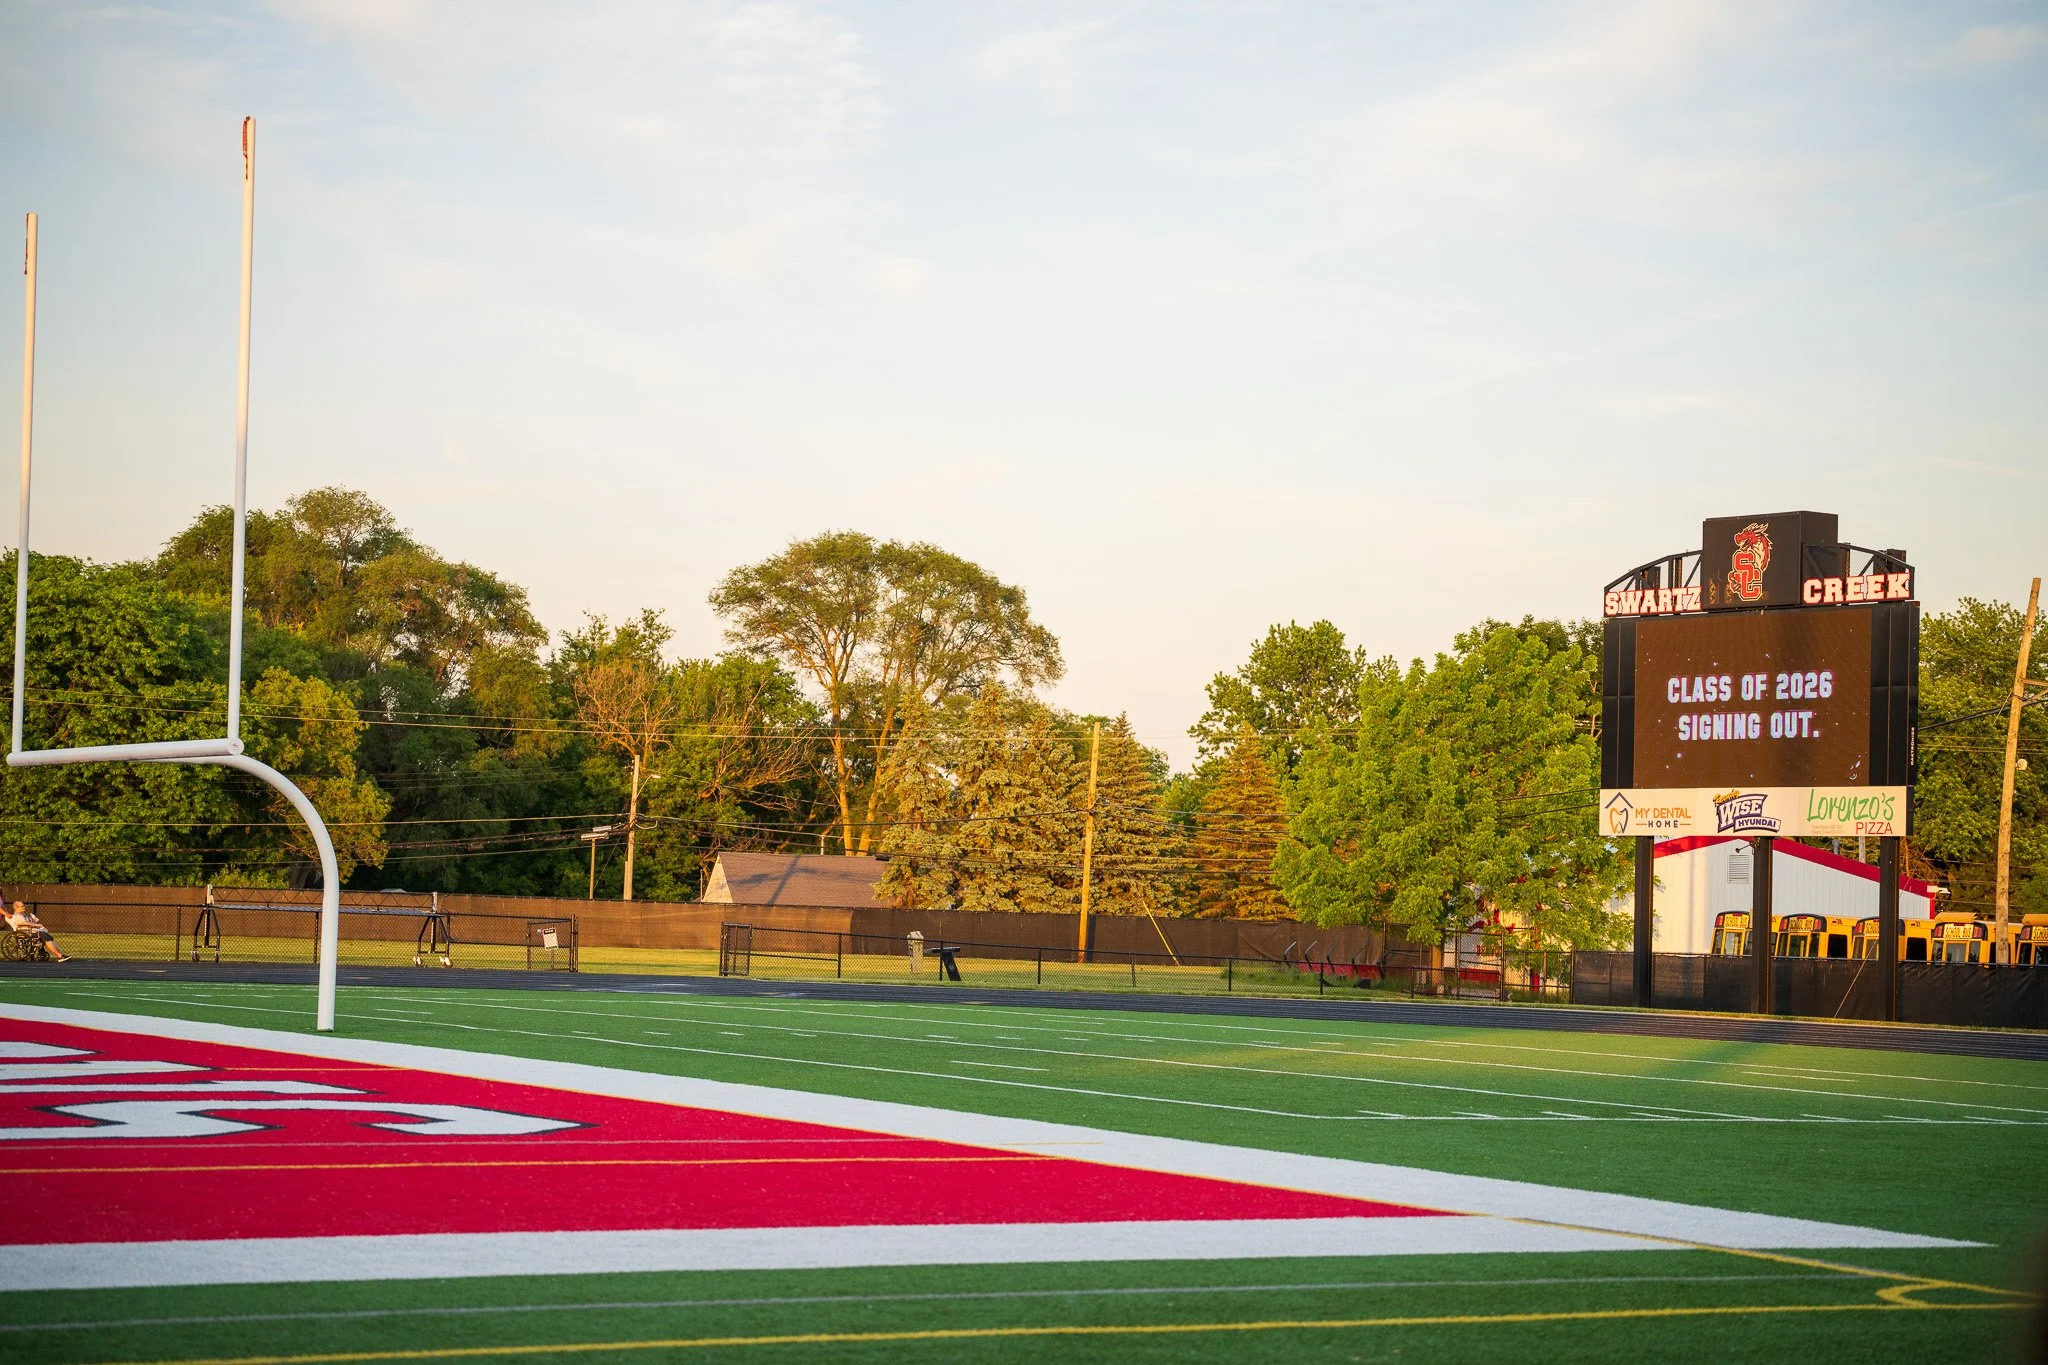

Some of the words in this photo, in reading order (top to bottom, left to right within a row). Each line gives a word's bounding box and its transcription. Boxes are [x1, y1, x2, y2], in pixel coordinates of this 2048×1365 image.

[1604, 586, 1702, 616] SWARTZ
[1803, 572, 1910, 604] CREEK
[1667, 675, 1732, 704] CLASS
[1741, 673, 1767, 701] OF
[1776, 671, 1833, 700] 2026
[1678, 712, 1761, 741] SIGNING
[1770, 711, 1820, 739] OUT.
[1635, 807, 1651, 819] MY
[1653, 807, 1692, 819] DENTAL
[1806, 788, 1896, 823] Lorenzo's
[1648, 820, 1679, 828] HOME
[1738, 818, 1777, 828] HYUNDAI
[1855, 821, 1893, 835] PIZZA
